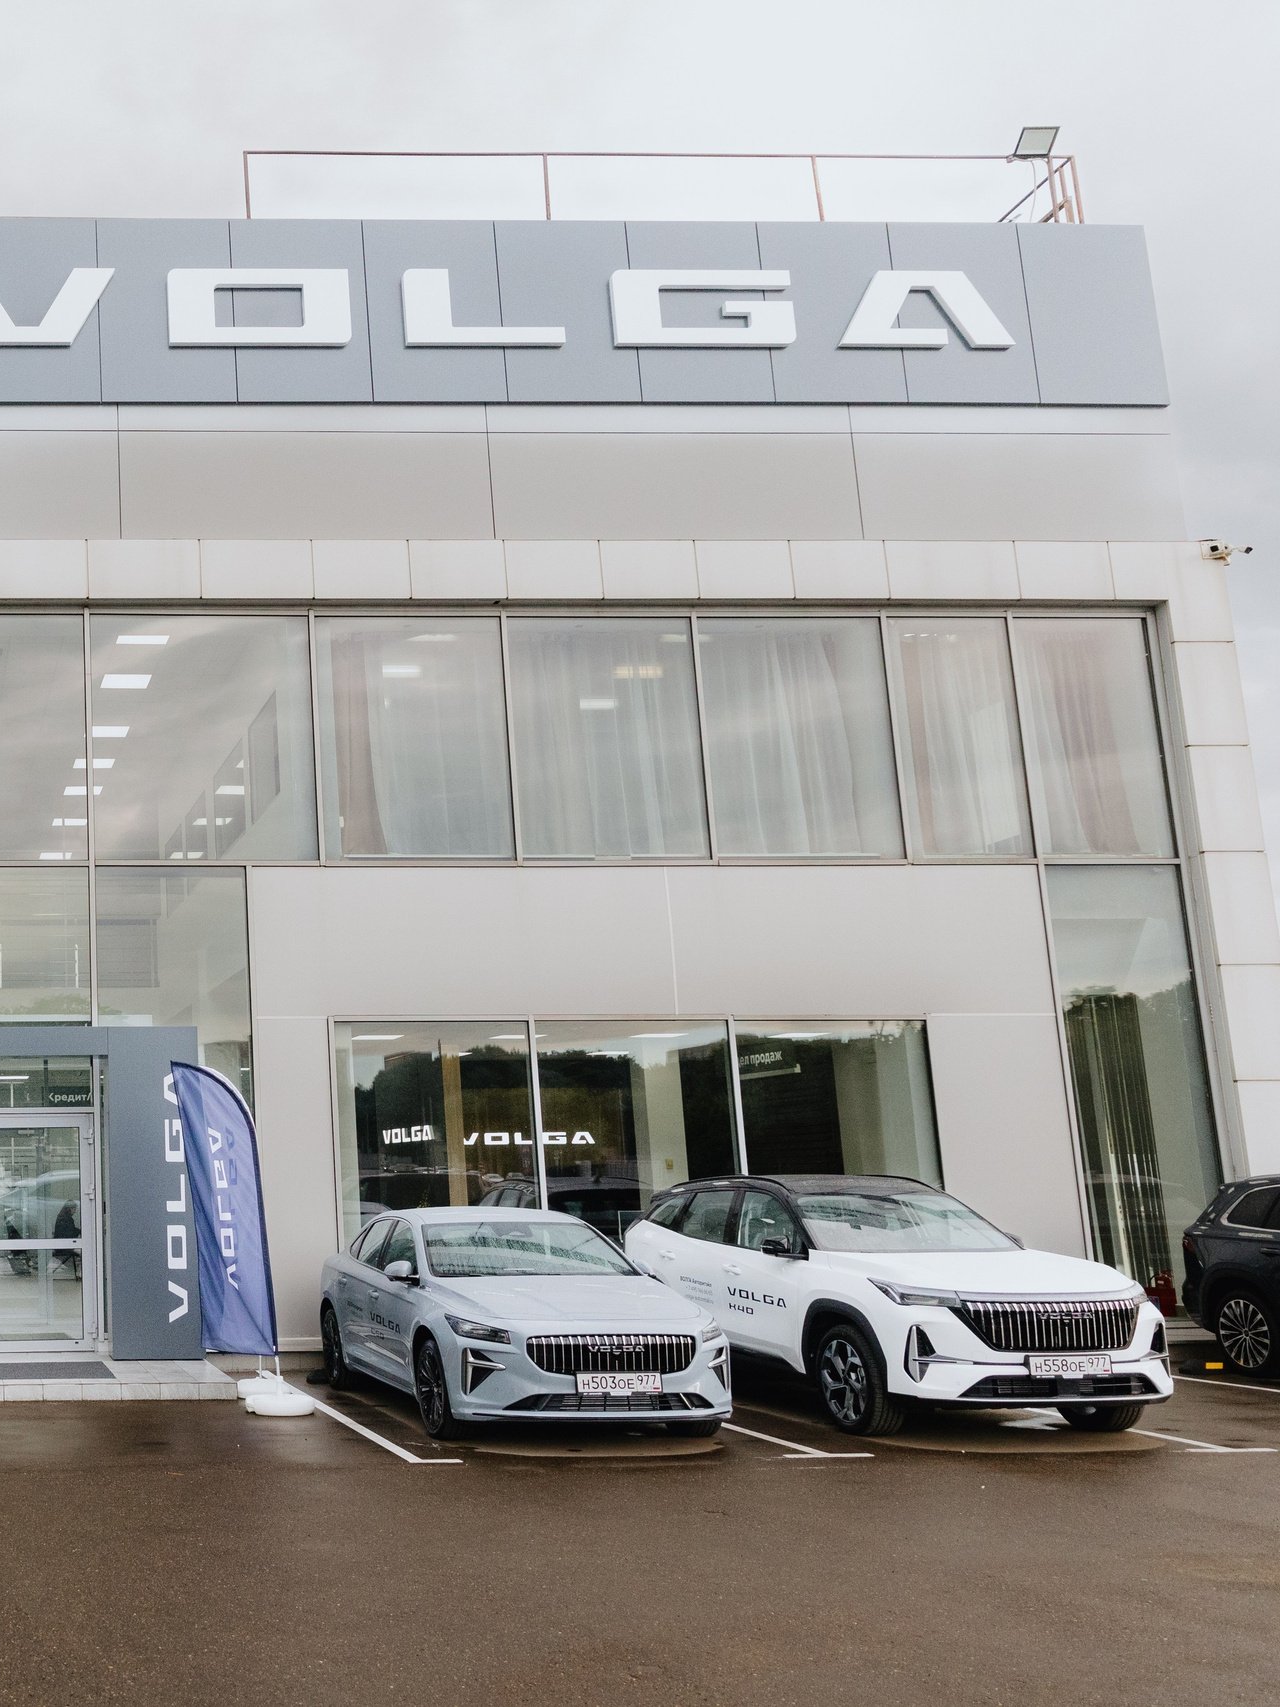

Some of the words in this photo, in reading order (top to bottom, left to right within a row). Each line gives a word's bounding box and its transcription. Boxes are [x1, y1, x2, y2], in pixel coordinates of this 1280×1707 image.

[750, 1051, 783, 1066] продаж
[382, 1125, 434, 1144] VOLGA
[727, 1286, 787, 1308] VOLGA
[729, 1303, 754, 1315] K40
[370, 1311, 401, 1334] VOLGA
[1036, 1312, 1093, 1320] VOLGA
[1087, 1357, 1107, 1368] 977
[637, 1374, 657, 1385] 977
